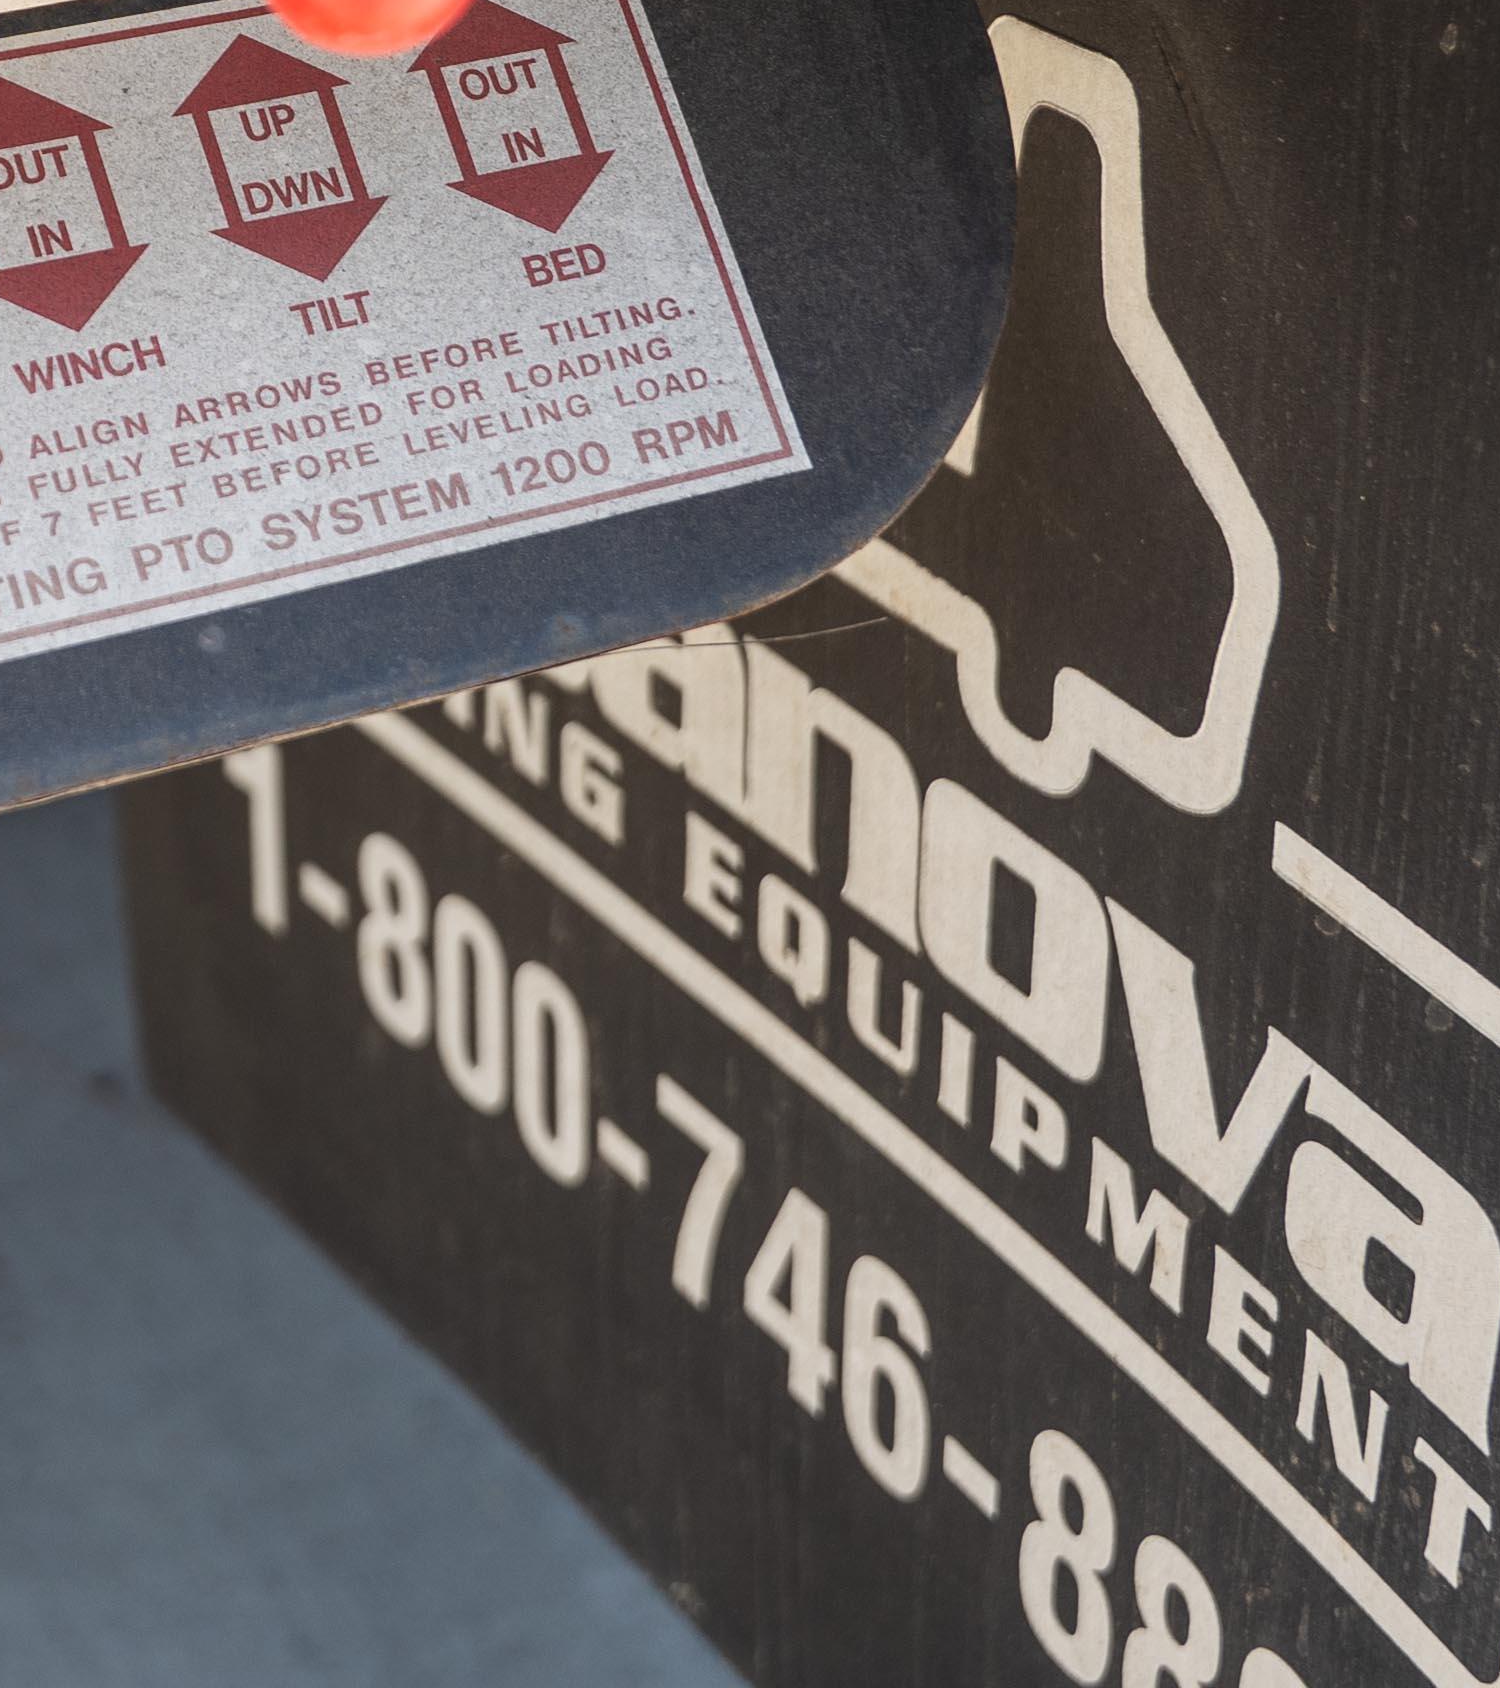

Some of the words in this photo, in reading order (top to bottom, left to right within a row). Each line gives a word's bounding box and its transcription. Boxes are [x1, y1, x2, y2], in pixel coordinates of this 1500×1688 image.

[454, 56, 545, 102] OUT
[237, 102, 301, 143] UP
[500, 127, 547, 164] IN
[239, 166, 345, 216] DWN
[24, 218, 75, 258] IN
[519, 240, 611, 289] BED
[287, 289, 379, 337] TILT
[10, 332, 168, 397] WINCH
[22, 410, 151, 461] ALIGN
[168, 369, 345, 429] ARROWS
[362, 329, 525, 386] BEFORE
[541, 292, 697, 347] TILTING.
[26, 451, 149, 501] FULLY
[167, 399, 386, 469] EXTENDED
[404, 377, 486, 416] FOR
[502, 335, 675, 394] LOADING
[40, 510, 65, 538] 7
[84, 482, 189, 528] FEET
[209, 439, 381, 500] BEFORE
[401, 391, 594, 456] LEVELING
[611, 362, 723, 408] LOAD.
[127, 524, 239, 583] PTO
[256, 470, 473, 552] SYSTEM
[488, 437, 615, 498] 1200
[629, 408, 741, 464] RPM
[222, 744, 1310, 1688] 1-800-746-88
[683, 811, 1493, 1589] EQUIPMENT
